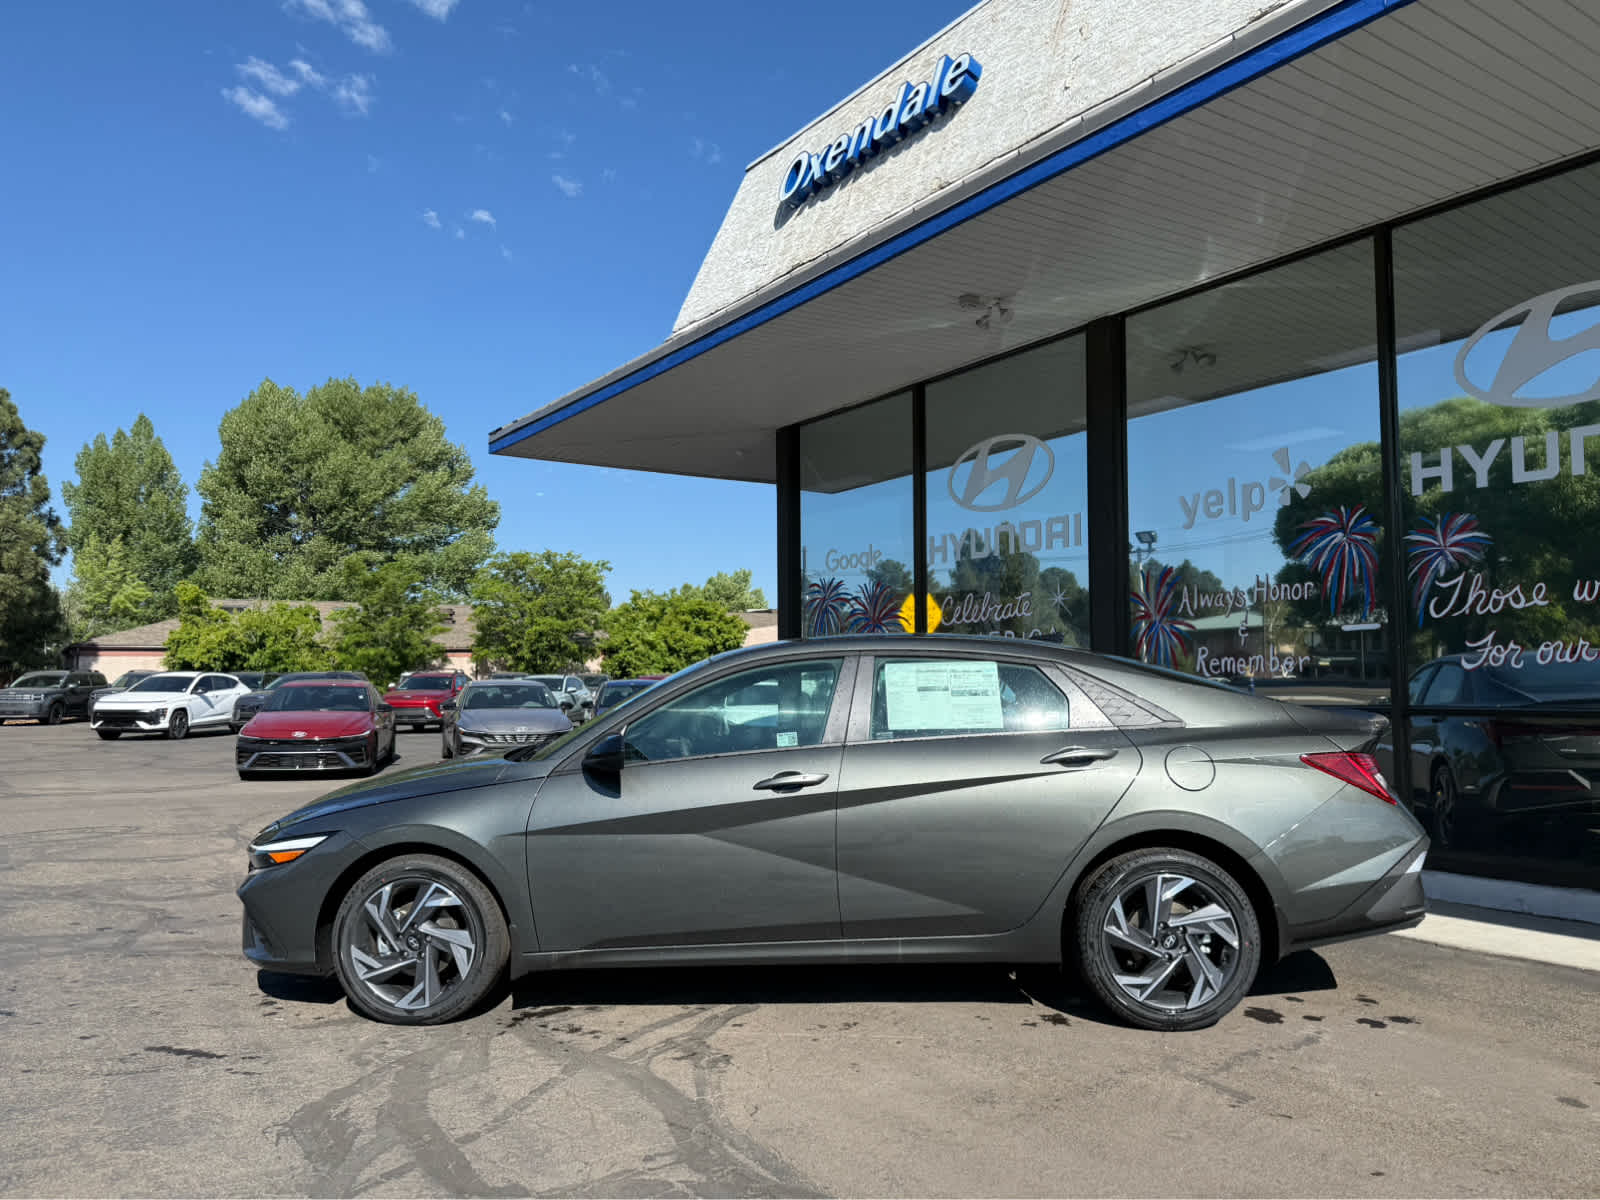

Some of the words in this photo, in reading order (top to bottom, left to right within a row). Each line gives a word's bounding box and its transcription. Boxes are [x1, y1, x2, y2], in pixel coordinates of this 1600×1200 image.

[779, 52, 982, 203] Oxendale
[1179, 477, 1265, 530] yelp
[825, 543, 882, 573] Google
[928, 512, 1083, 566] HYUNDAI
[941, 591, 1034, 626] Celebrate
[1177, 584, 1247, 618] Always
[1253, 573, 1314, 603] Honor
[1429, 571, 1550, 619] Those
[1196, 646, 1311, 678] Remember
[1461, 630, 1524, 670] For
[1536, 636, 1600, 665] our
